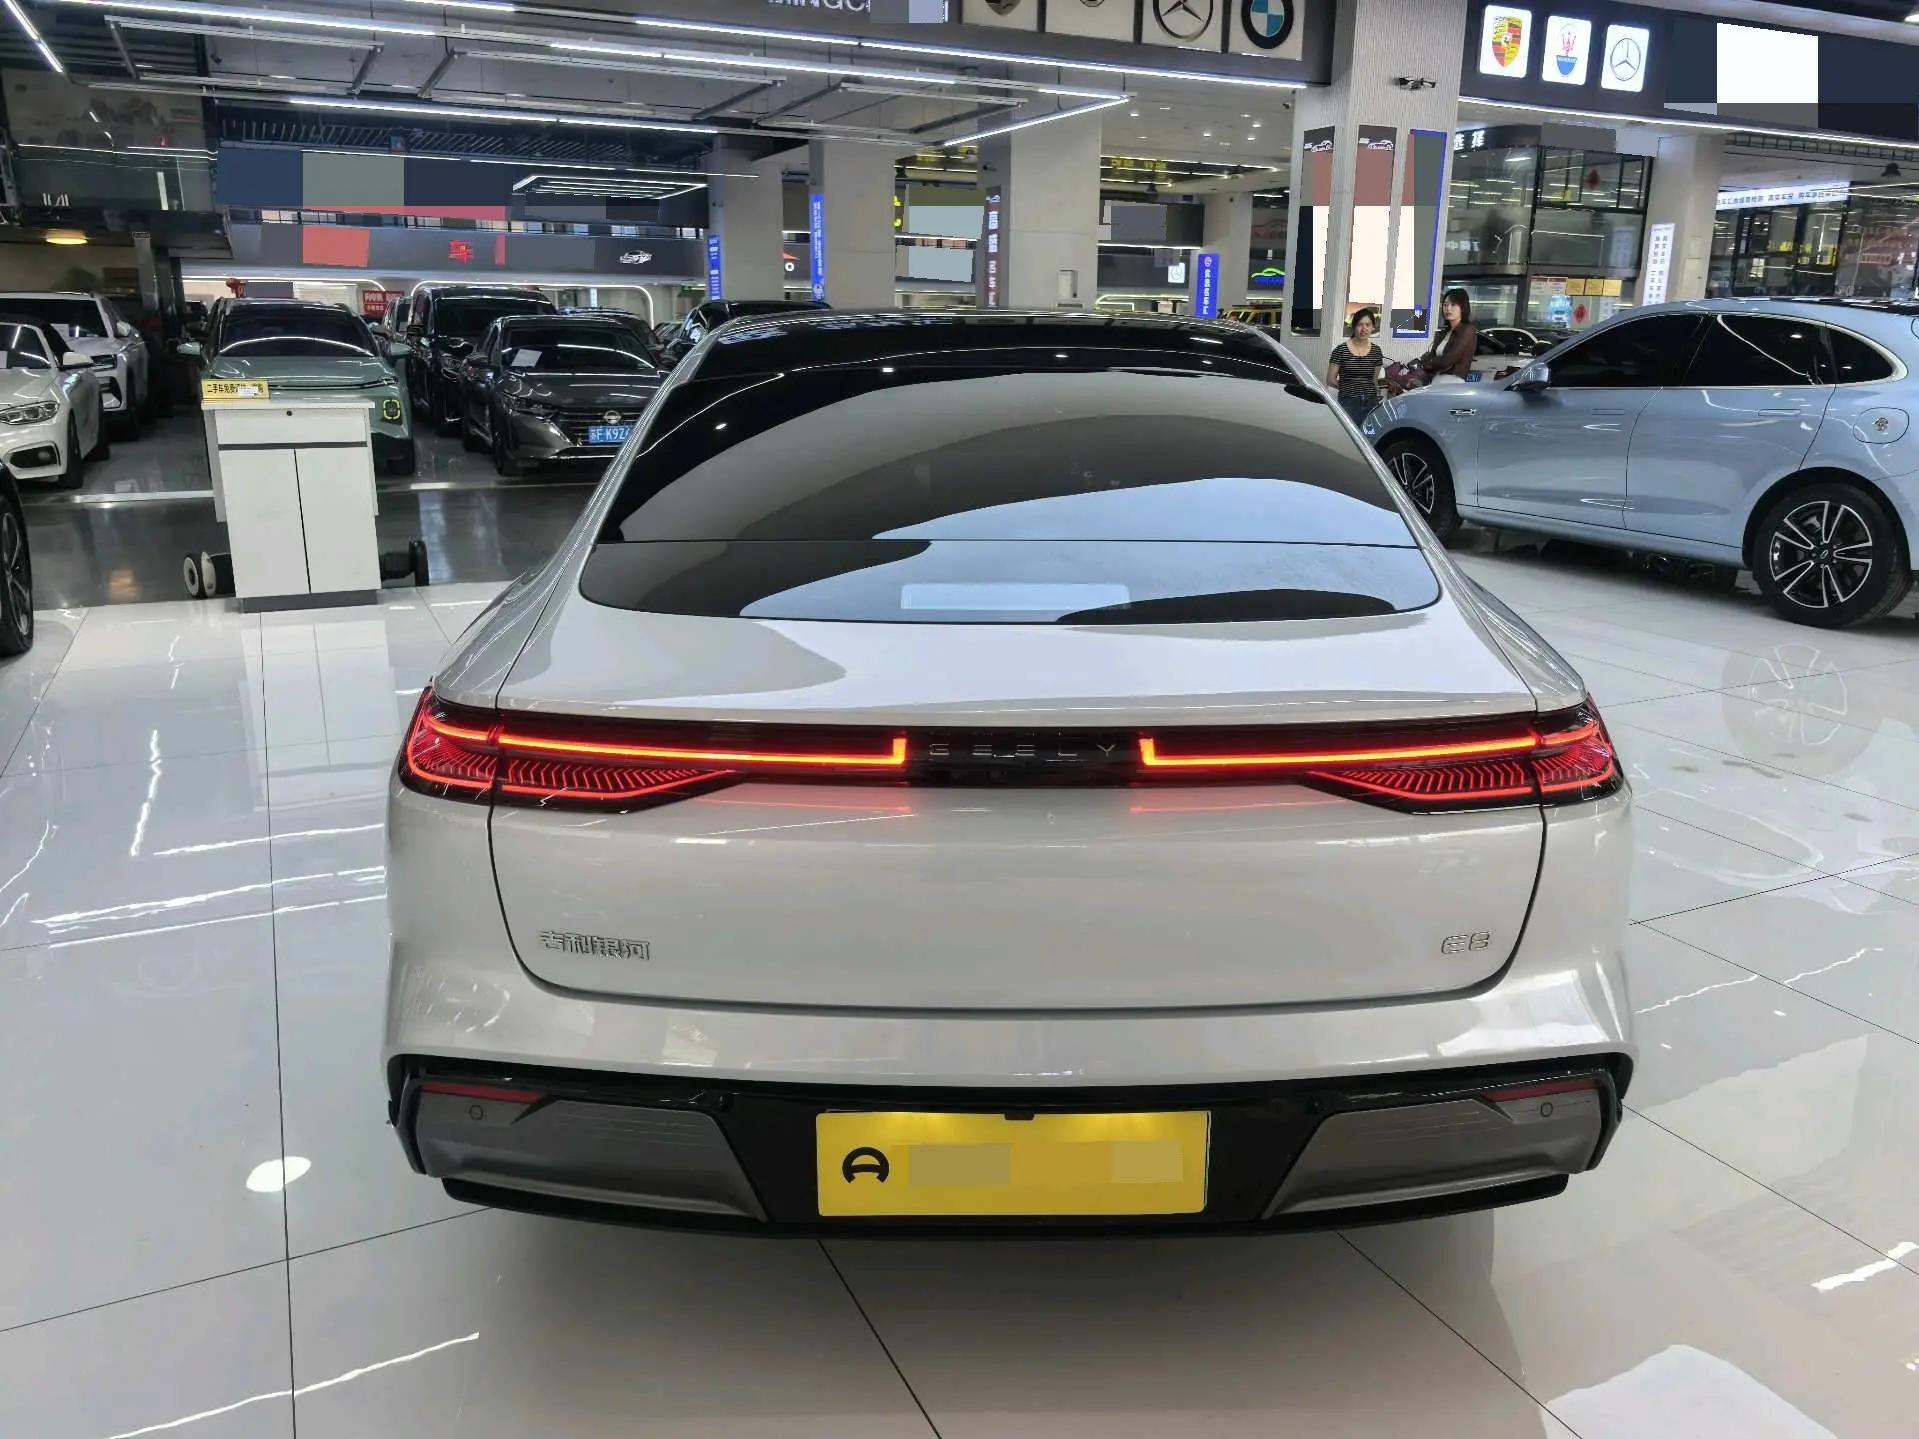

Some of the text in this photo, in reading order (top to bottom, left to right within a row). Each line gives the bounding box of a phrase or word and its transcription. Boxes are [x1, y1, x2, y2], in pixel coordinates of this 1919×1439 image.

[929, 743, 1116, 758] GEELY
[540, 929, 650, 961] 吉利银河
[1441, 931, 1491, 955] E8
